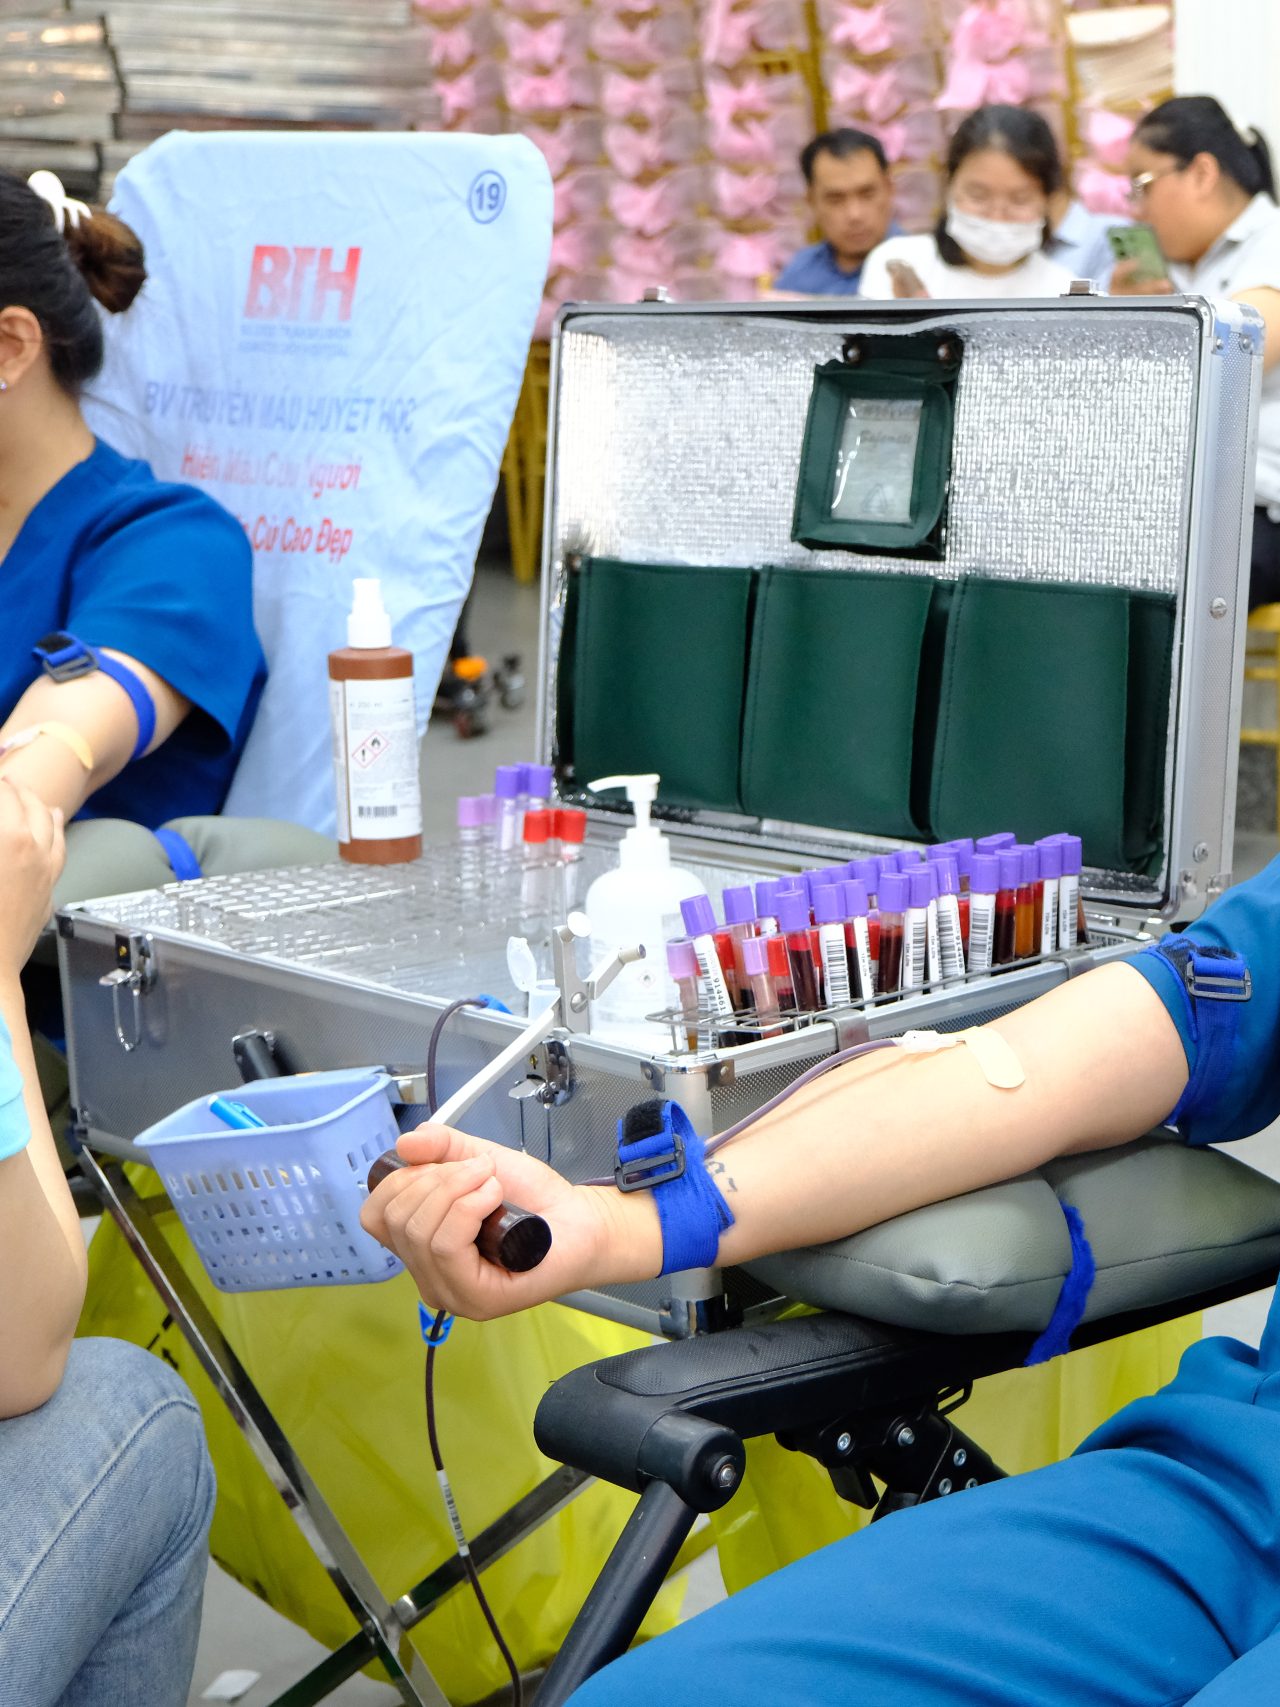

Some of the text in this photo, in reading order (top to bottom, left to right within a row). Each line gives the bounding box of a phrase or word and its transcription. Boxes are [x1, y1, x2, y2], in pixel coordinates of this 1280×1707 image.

[476, 182, 500, 211] 19
[243, 244, 361, 321] BTH
[281, 516, 312, 552] Cao
